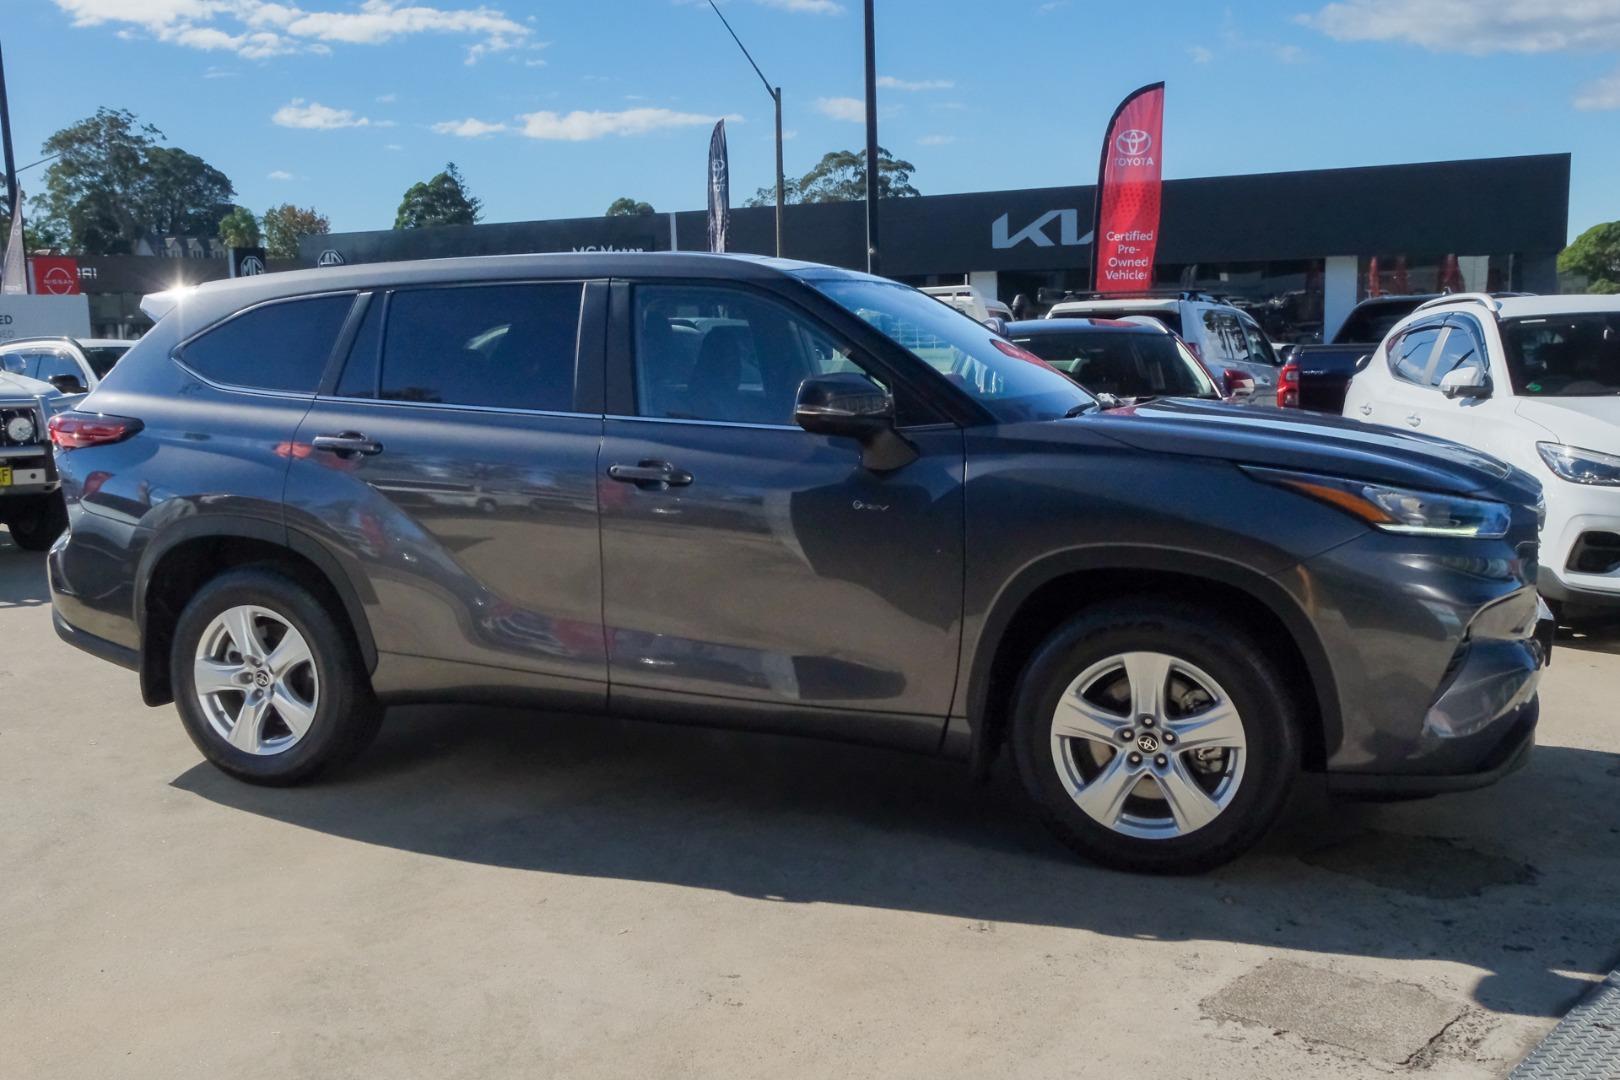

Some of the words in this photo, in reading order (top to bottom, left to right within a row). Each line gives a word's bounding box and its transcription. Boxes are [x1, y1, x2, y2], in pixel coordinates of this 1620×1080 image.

[1114, 156, 1154, 167] TOYOTA
[1106, 230, 1154, 241] Certified
[1117, 244, 1141, 254] Pre-
[1108, 256, 1149, 267] Owned
